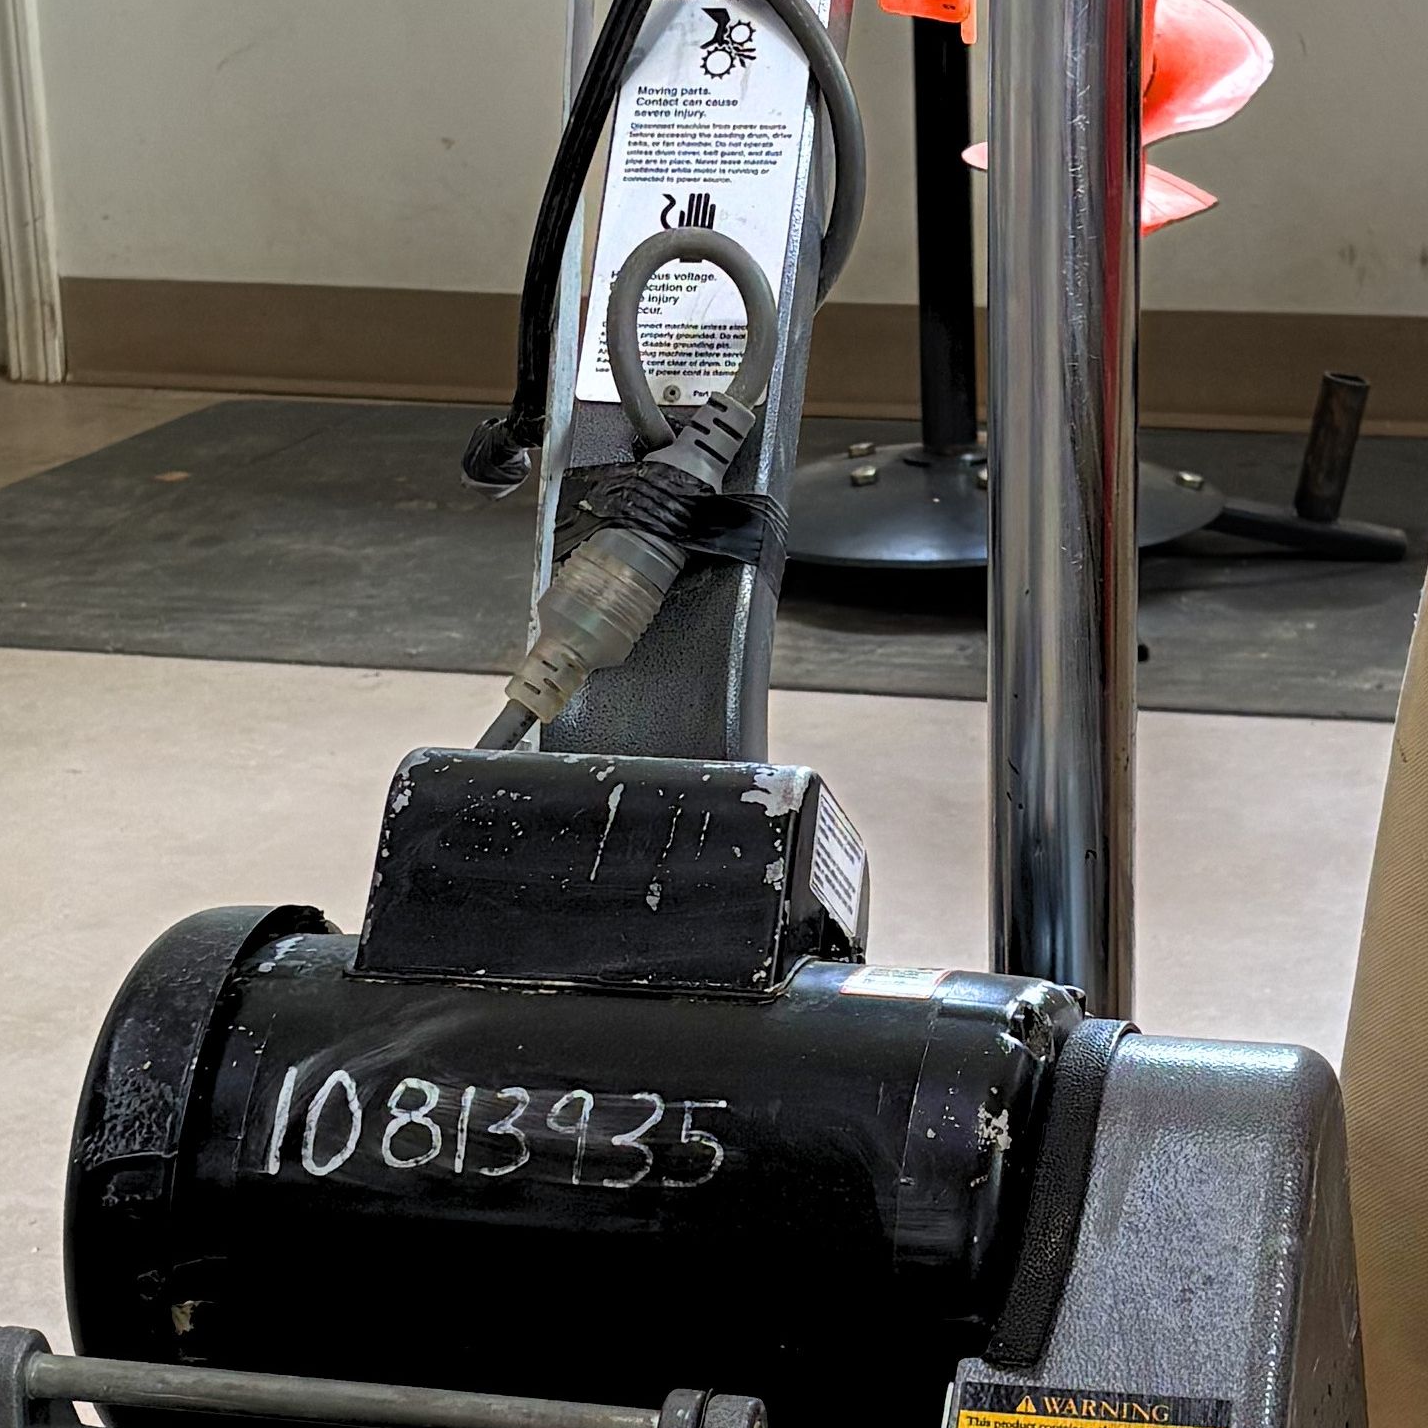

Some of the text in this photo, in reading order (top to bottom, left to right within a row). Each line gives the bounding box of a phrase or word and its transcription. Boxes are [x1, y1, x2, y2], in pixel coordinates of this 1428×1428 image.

[638, 86, 711, 97] Moving parts.
[636, 97, 679, 107] Contact
[682, 98, 702, 107] can
[634, 109, 671, 117] severe
[673, 272, 718, 284] voltage.
[685, 284, 698, 292] or
[267, 1066, 728, 1188] 10813935
[1042, 1396, 1170, 1423] WARNING
[966, 1415, 991, 1427] This
